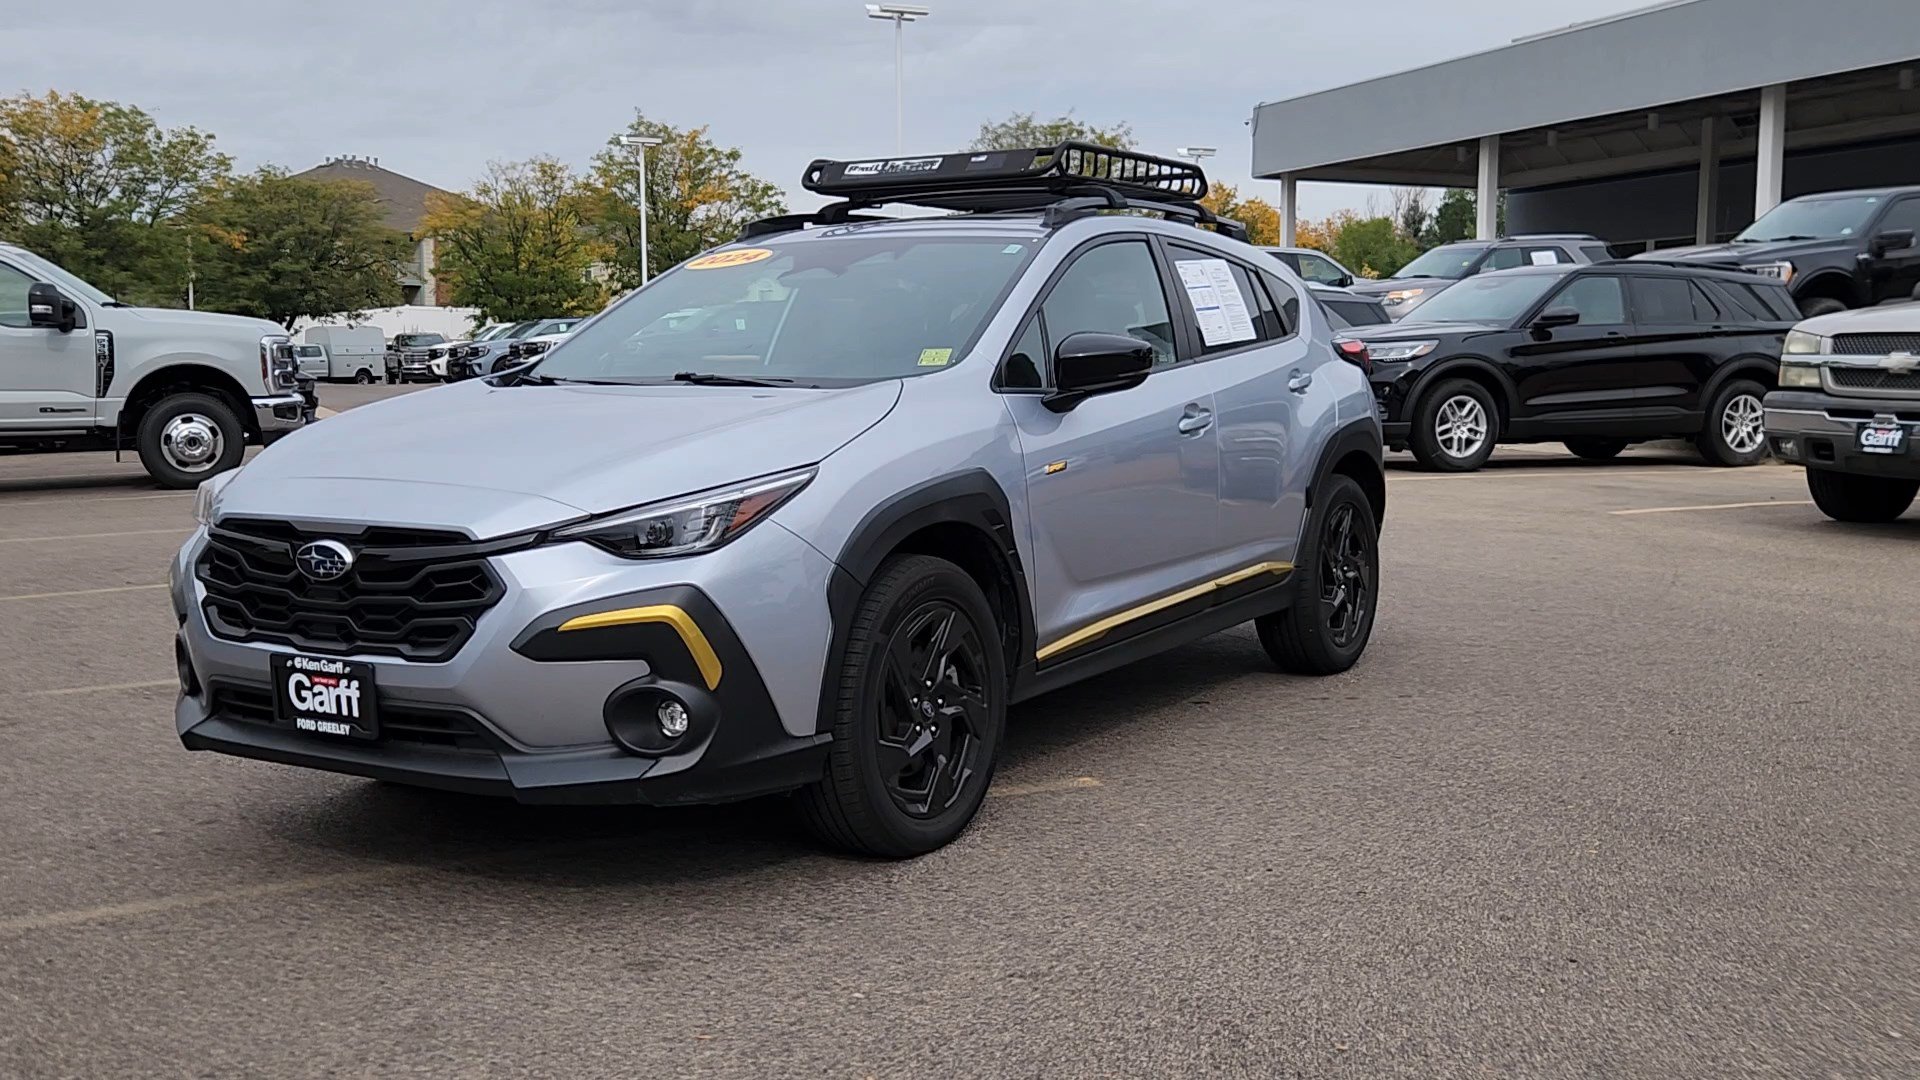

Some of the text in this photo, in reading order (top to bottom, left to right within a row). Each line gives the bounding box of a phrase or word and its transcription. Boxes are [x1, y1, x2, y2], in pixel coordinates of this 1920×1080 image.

[1861, 428, 1903, 447] Garff
[302, 658, 343, 674] Ken Garff
[288, 673, 360, 718] Garff
[297, 718, 350, 736] FORD GREELEY
